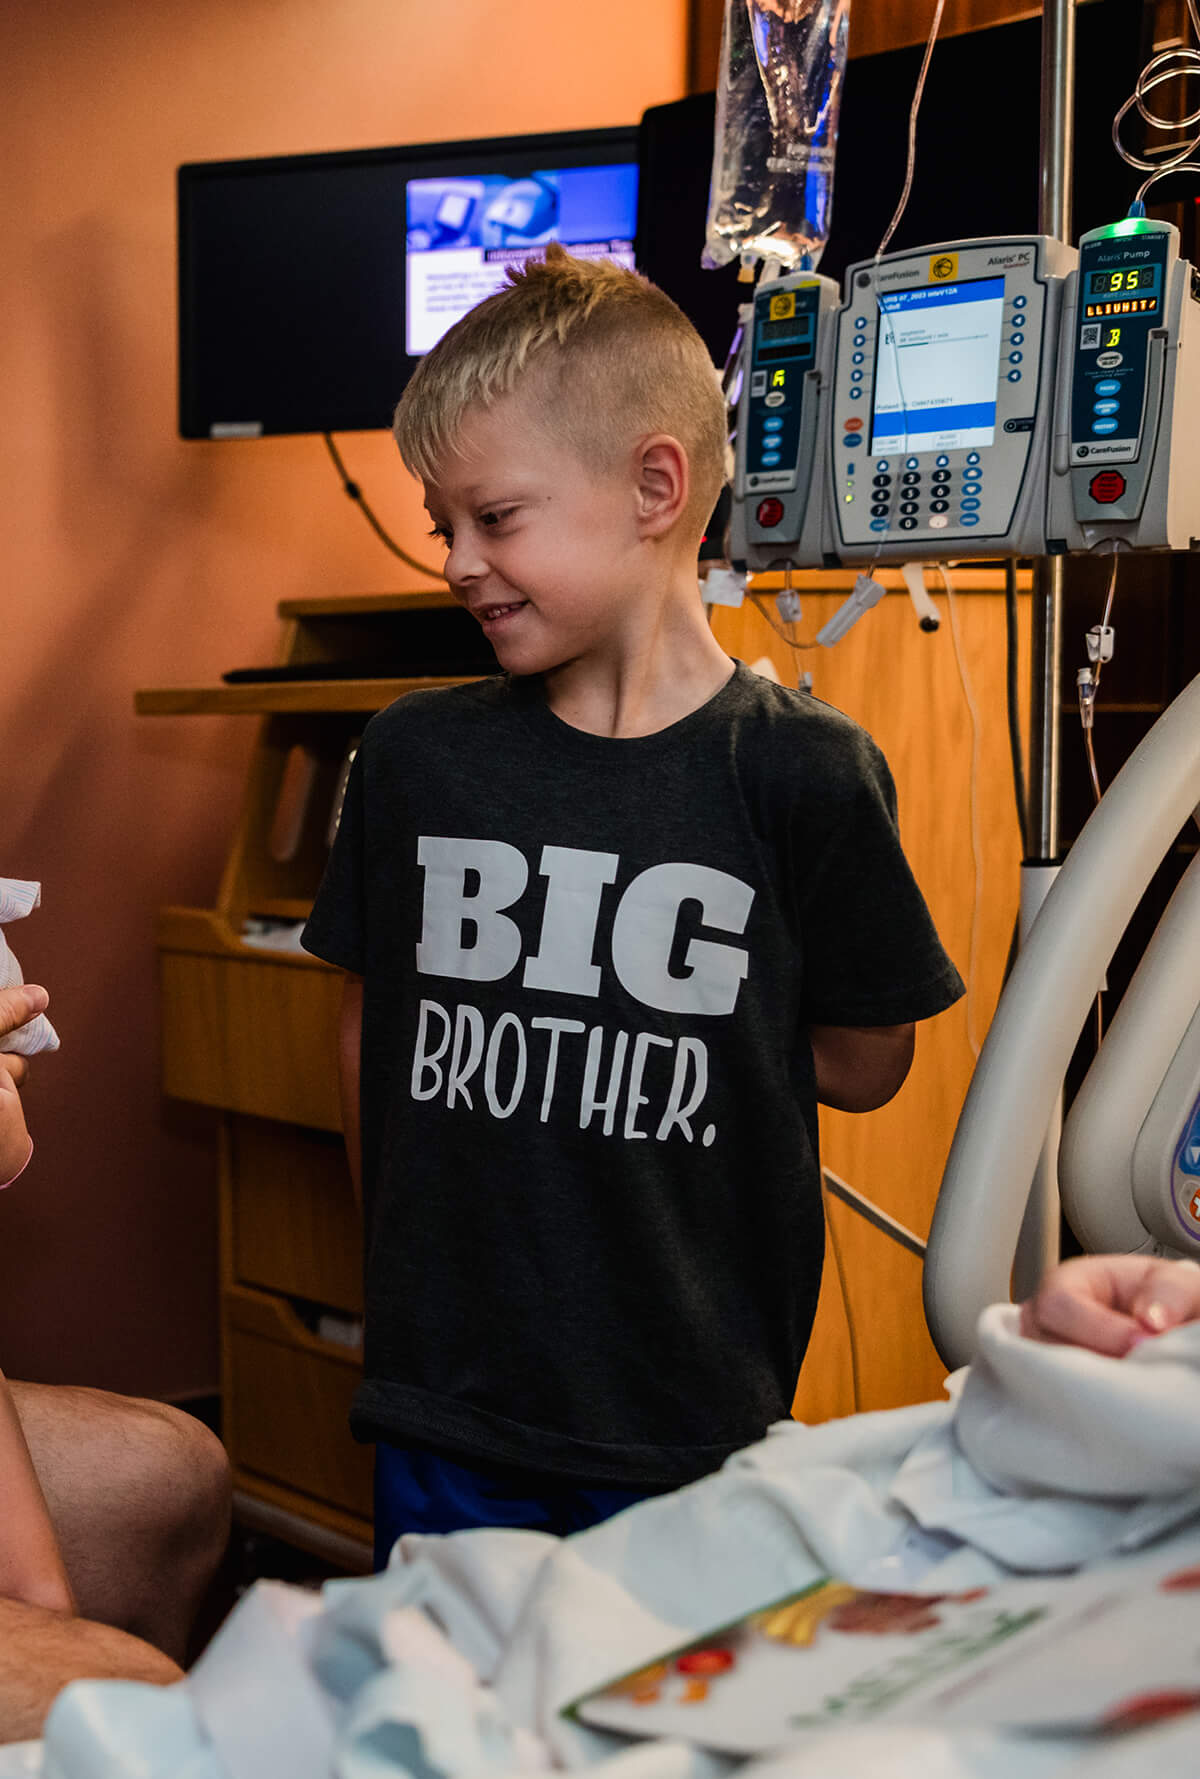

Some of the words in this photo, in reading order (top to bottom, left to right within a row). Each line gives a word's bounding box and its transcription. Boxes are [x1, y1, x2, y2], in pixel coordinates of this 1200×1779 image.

[988, 254, 1016, 267] Alaris
[1018, 251, 1031, 262] PC
[1123, 250, 1150, 260] Pump
[876, 269, 919, 283] areFusion
[1110, 270, 1139, 292] 95
[1106, 328, 1121, 347] B
[773, 369, 786, 387] A
[1091, 446, 1131, 455] CareFusion
[416, 836, 756, 1016] BIG
[411, 999, 717, 1147] BROTHER.
